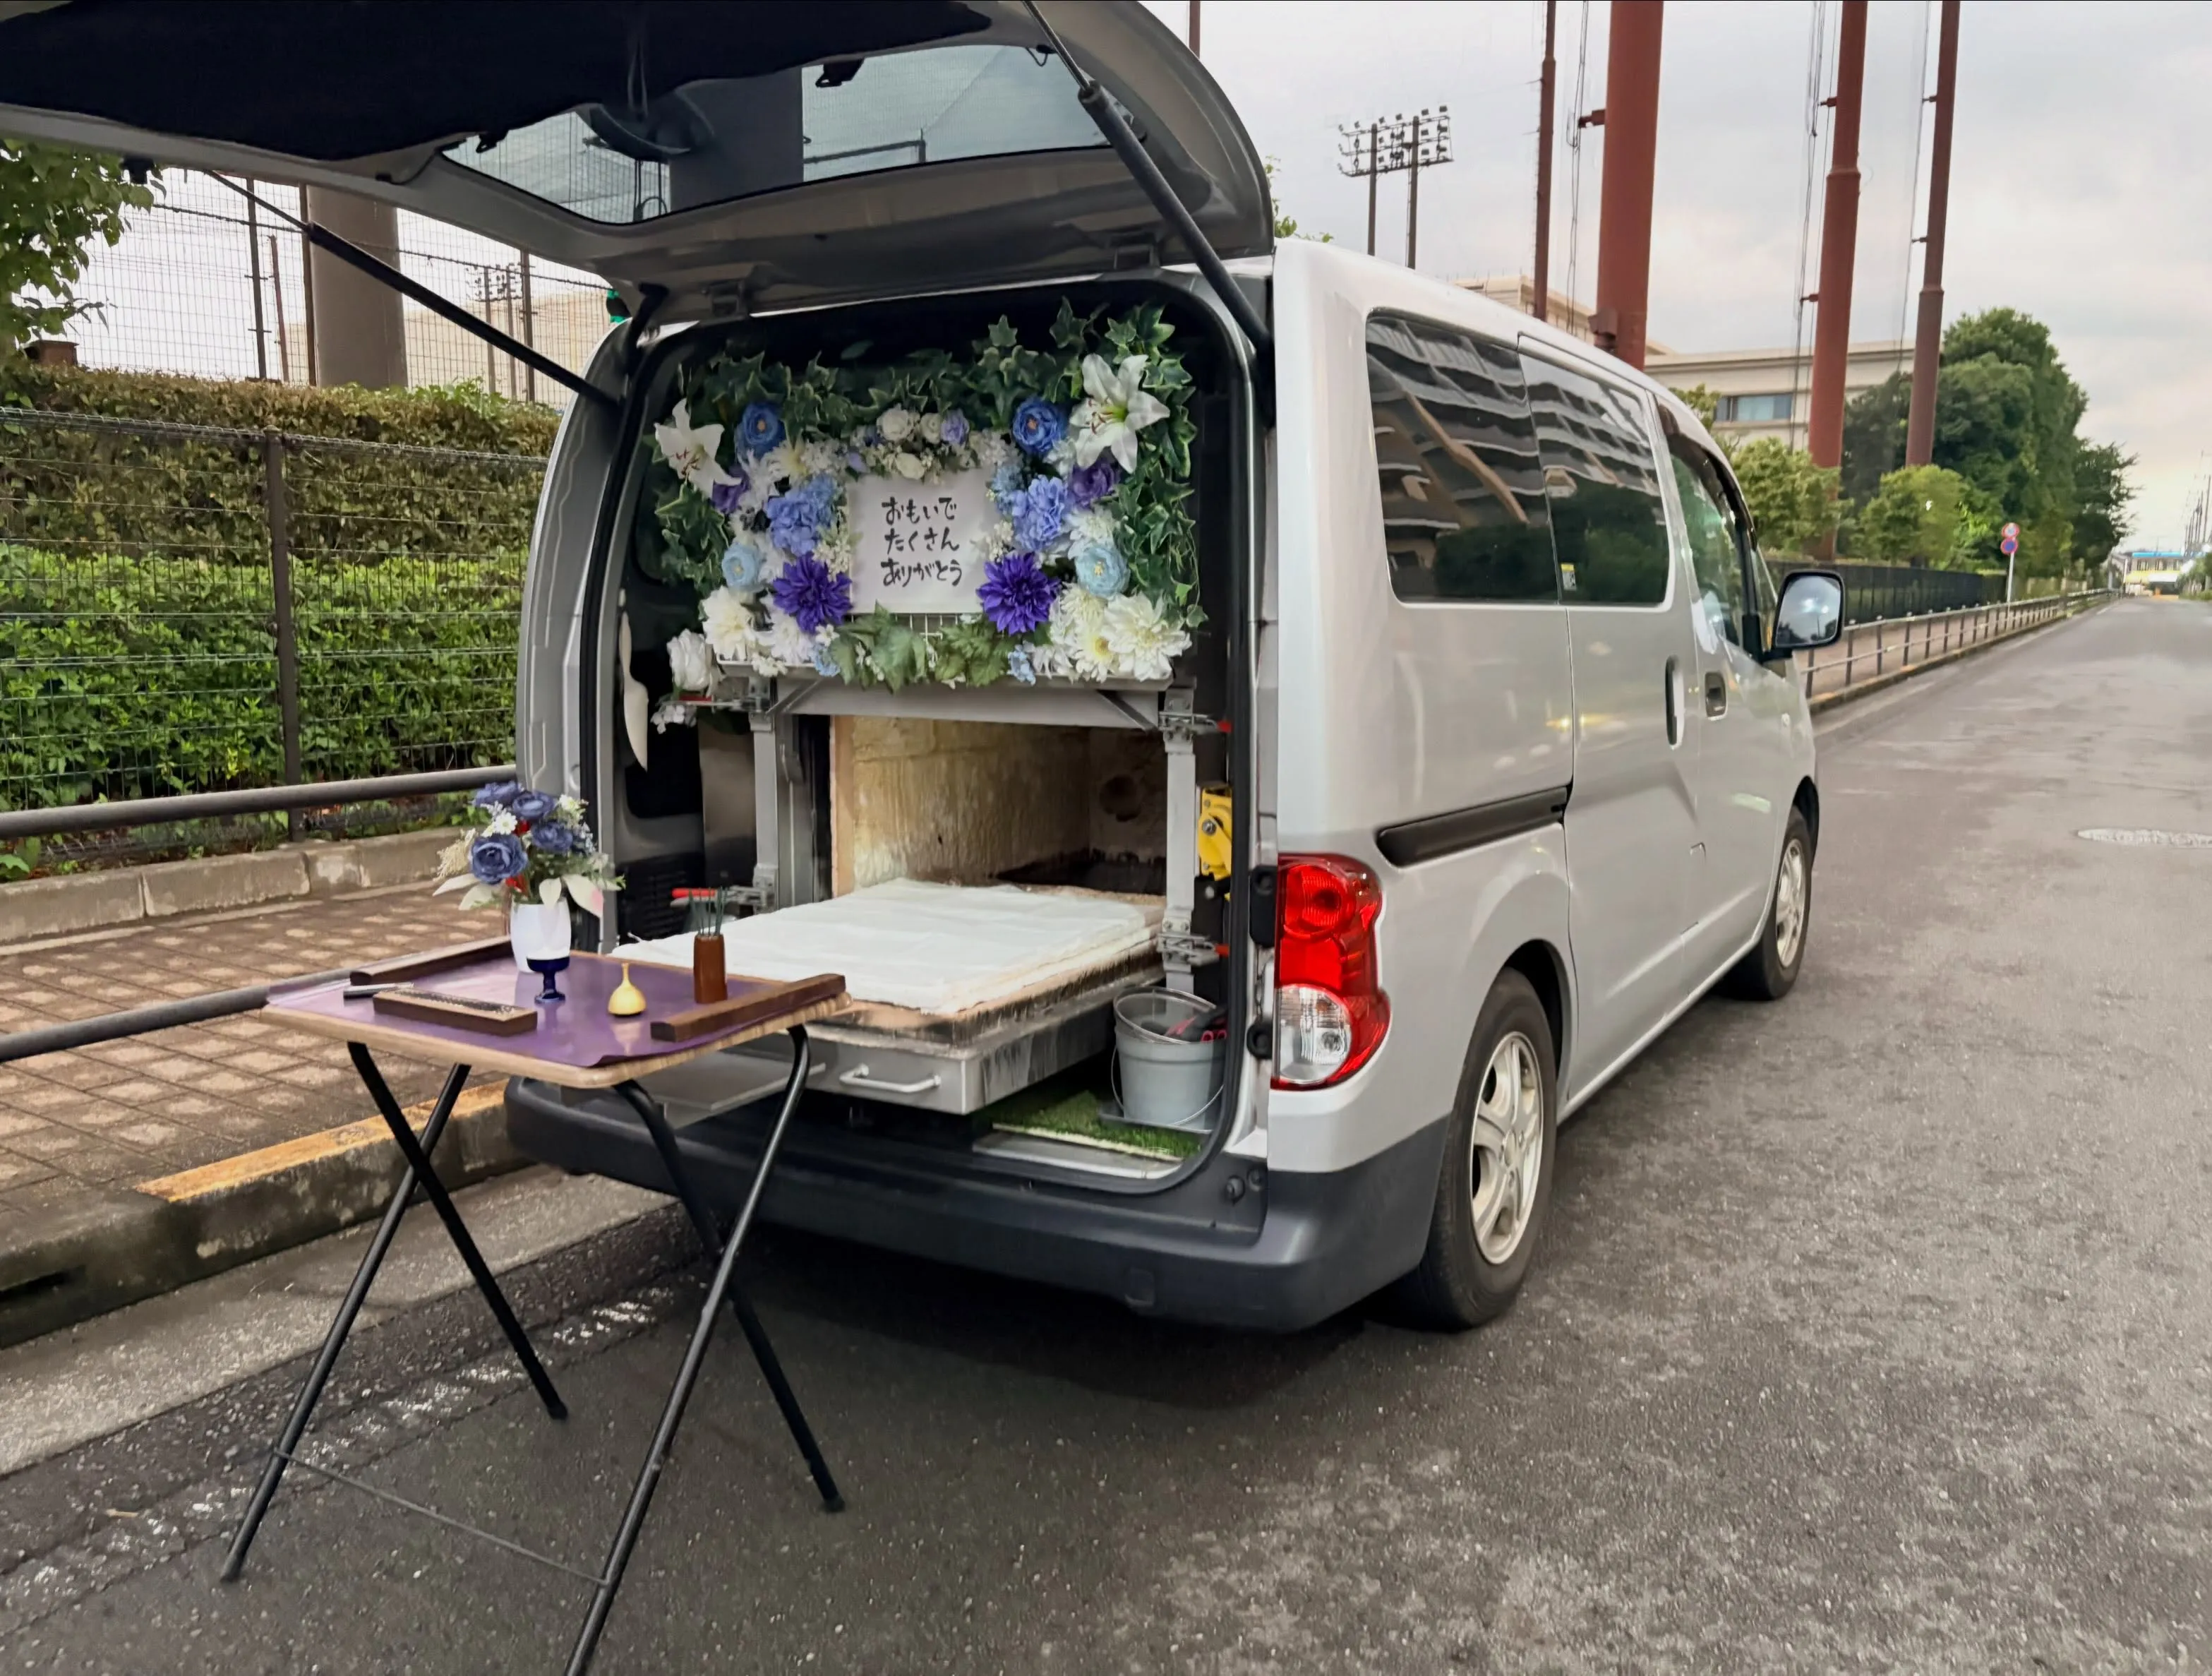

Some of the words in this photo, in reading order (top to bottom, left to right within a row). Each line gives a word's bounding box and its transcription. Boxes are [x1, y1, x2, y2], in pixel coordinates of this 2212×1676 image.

[882, 496, 957, 525] おもいで
[884, 527, 960, 554] たくさん
[880, 558, 962, 587] ありがとう
